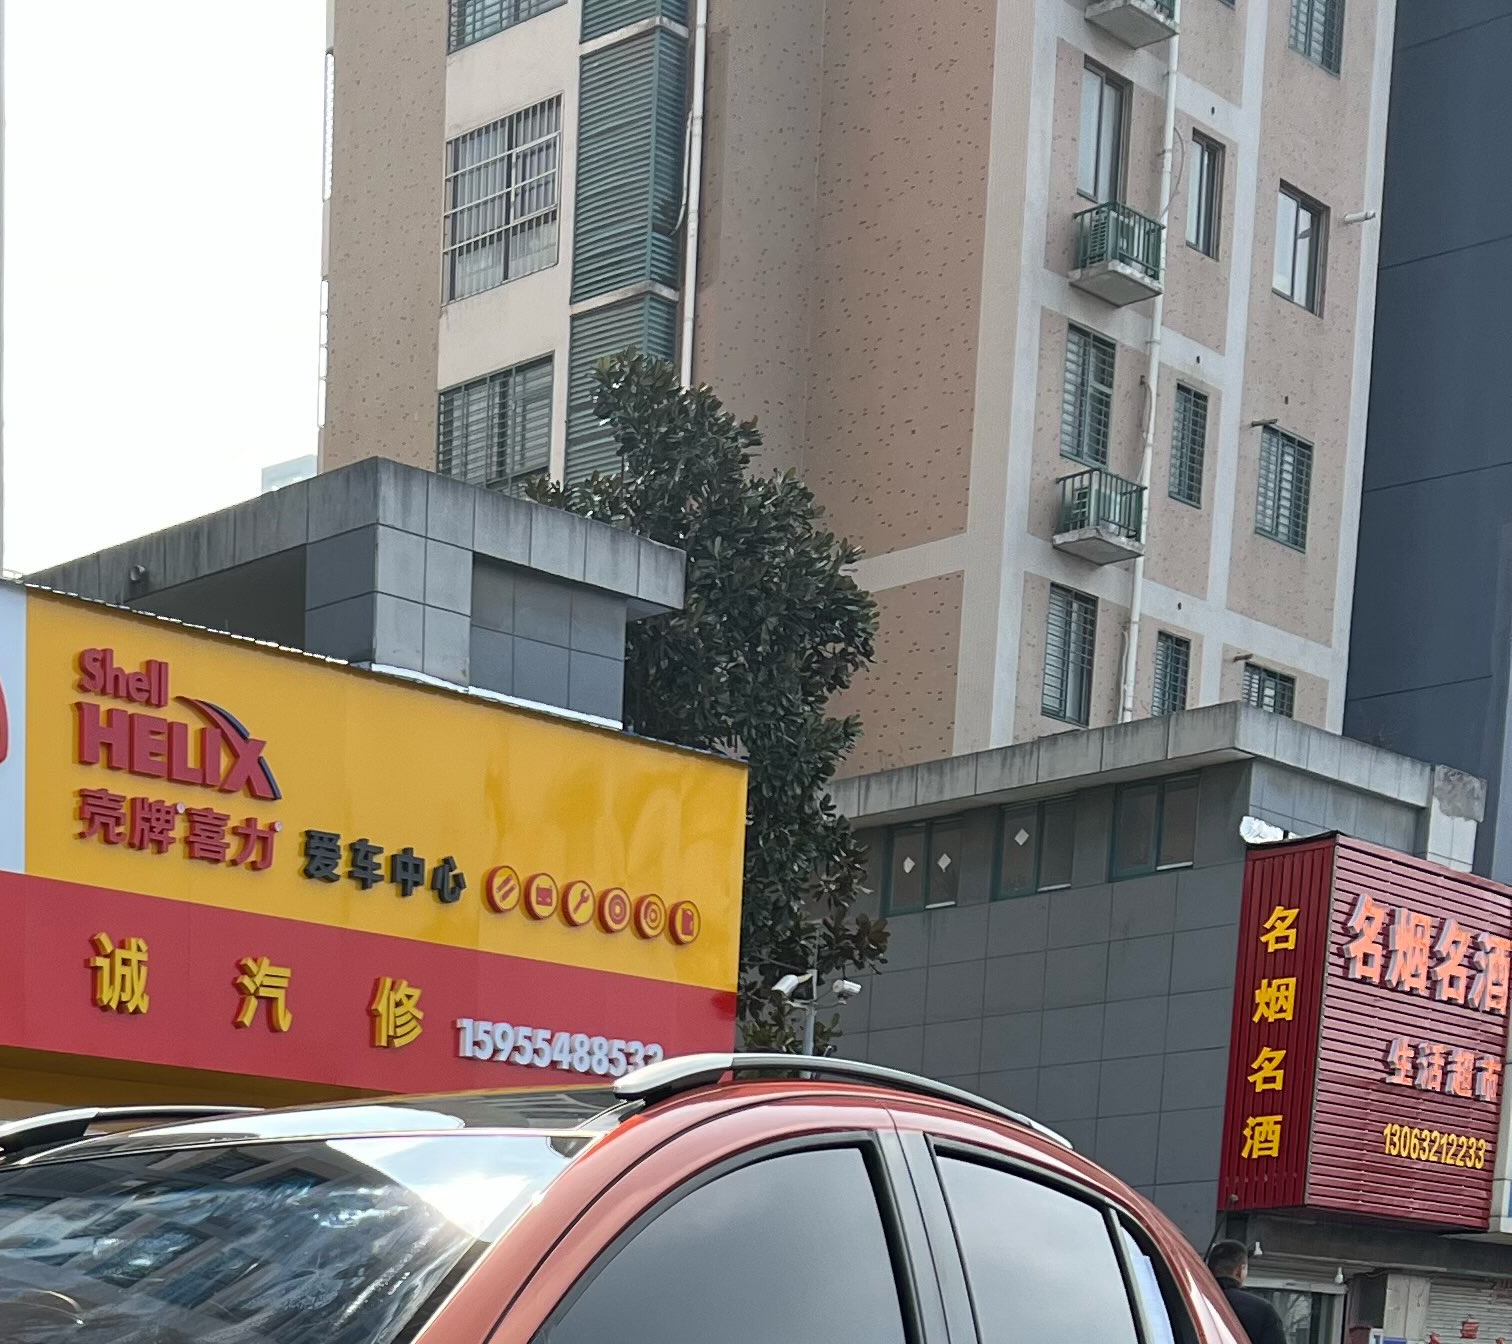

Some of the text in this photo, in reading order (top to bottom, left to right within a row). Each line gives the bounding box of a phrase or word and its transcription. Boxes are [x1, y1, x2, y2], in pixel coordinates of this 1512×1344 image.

[78, 648, 169, 708] Shell
[74, 697, 281, 800] HELIX
[77, 788, 467, 904] 壳牌喜力 爱车中心
[1343, 893, 1512, 1016] 名烟名酒
[1241, 905, 1301, 1159] 名烟名酒
[1386, 1036, 1502, 1102] 生活超市
[1383, 1122, 1489, 1170] 13063212233
